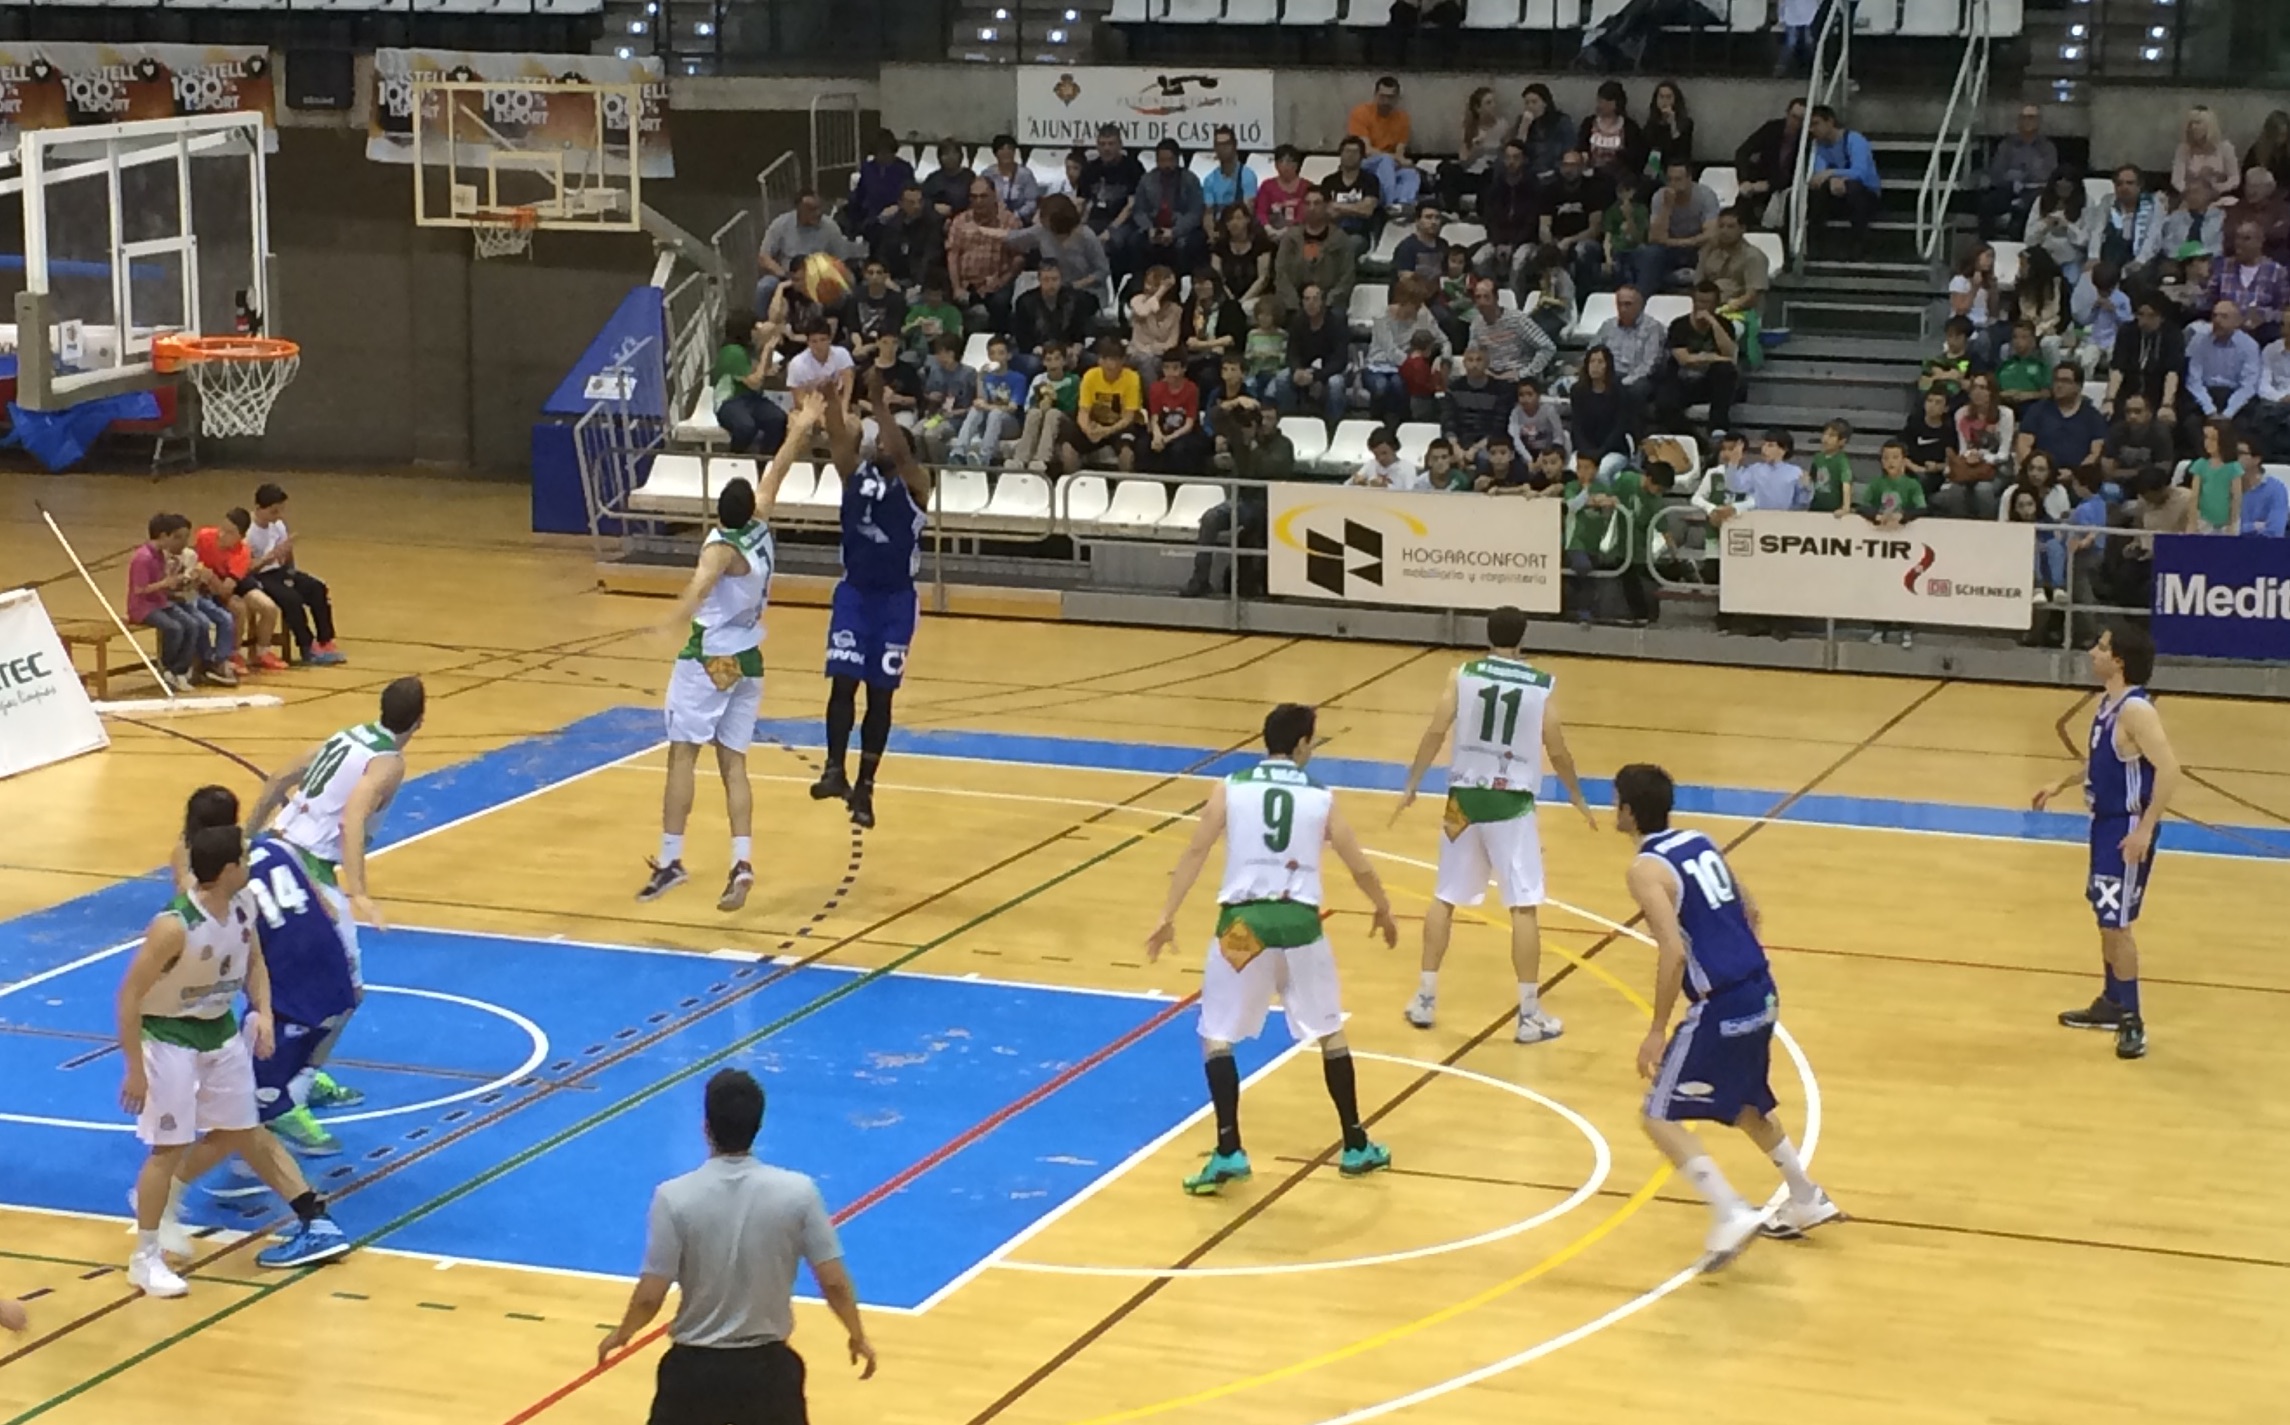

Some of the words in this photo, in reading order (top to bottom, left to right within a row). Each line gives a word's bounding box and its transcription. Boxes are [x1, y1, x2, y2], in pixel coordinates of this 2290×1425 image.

[1029, 119, 1140, 140] AJUNTANT
[1148, 121, 1168, 140] DE
[1402, 547, 1548, 569] HOGARCONFORT
[1759, 534, 1912, 560] SPAIN-TIR
[1955, 584, 2023, 599] SCHENKER
[1477, 685, 1523, 746] 11
[1263, 787, 1295, 853] 9
[247, 864, 310, 930] 14
[1681, 849, 1736, 910] 10
